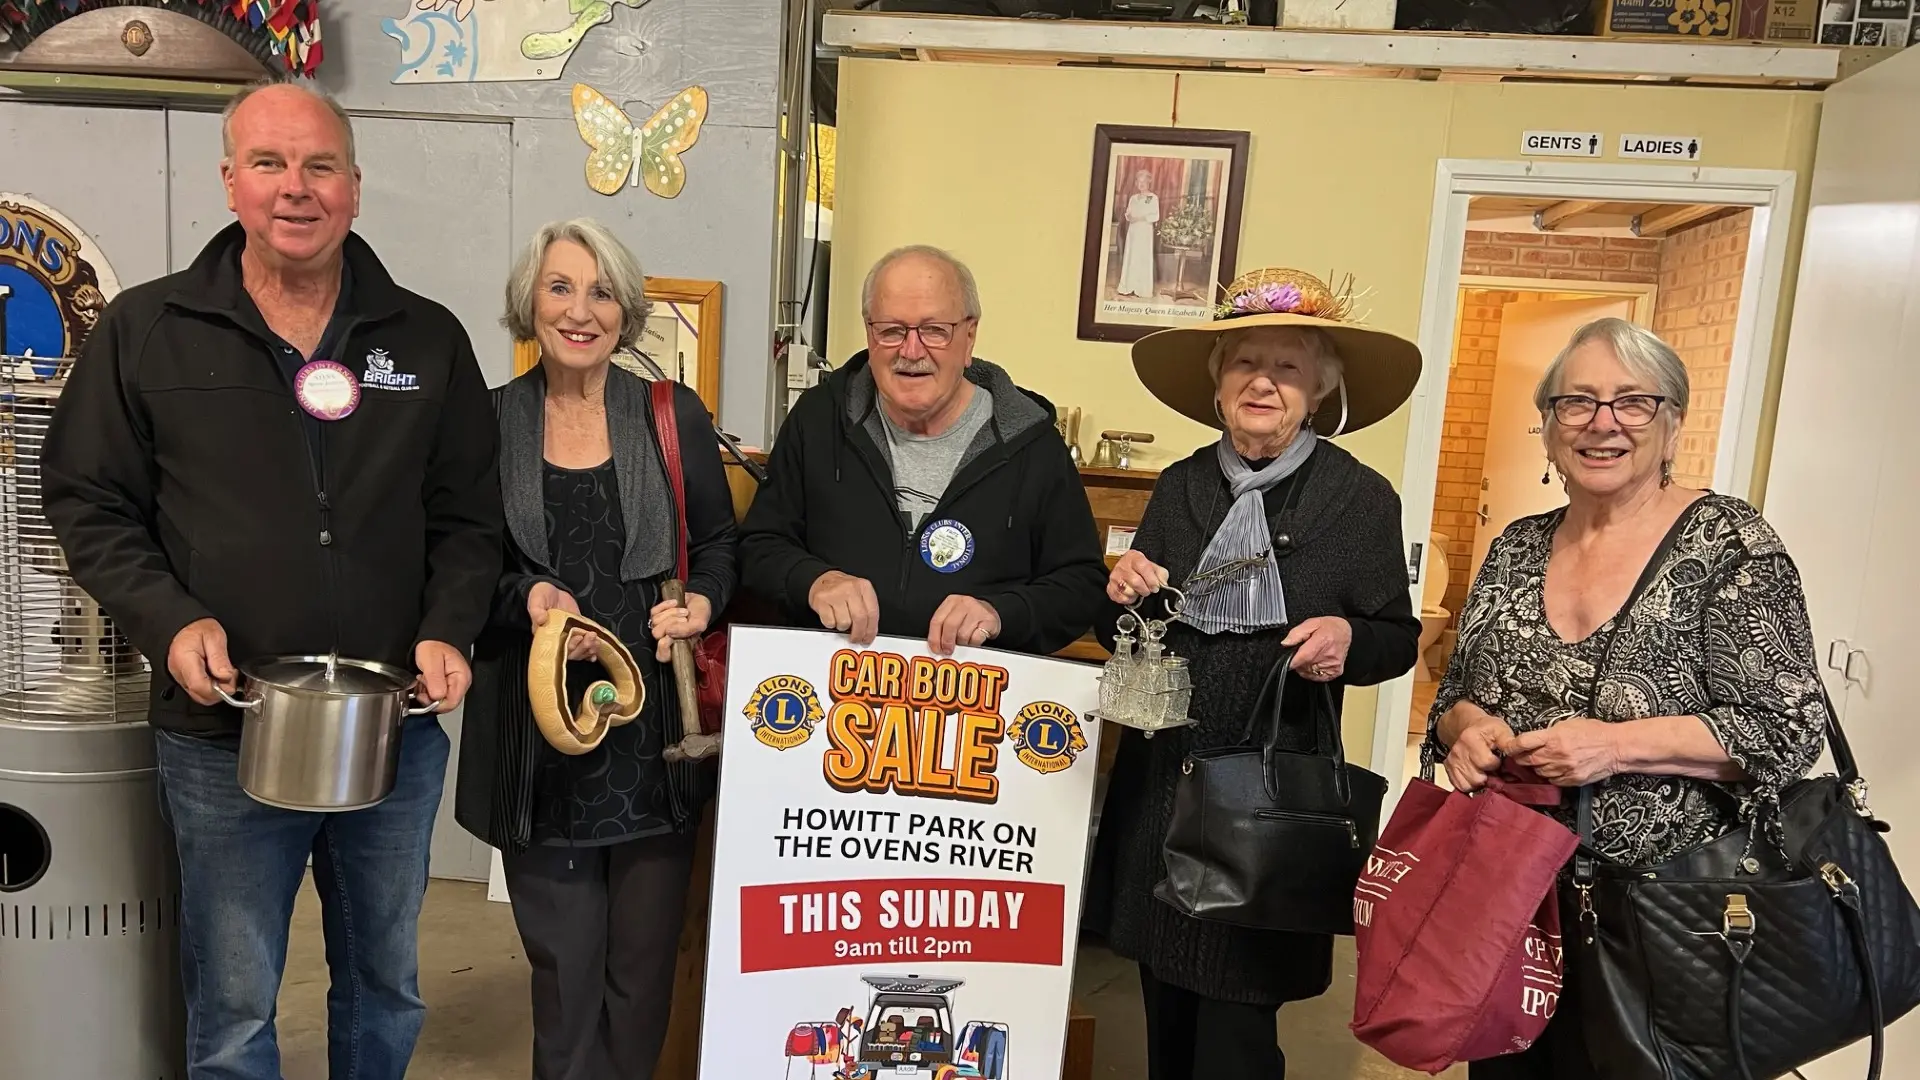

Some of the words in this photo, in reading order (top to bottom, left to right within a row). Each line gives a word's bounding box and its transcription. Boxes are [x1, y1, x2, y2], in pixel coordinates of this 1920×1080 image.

[1773, 6, 1796, 17] X12
[1527, 135, 1582, 150] GENTS
[1624, 139, 1683, 154] LADIES
[1118, 305, 1142, 314] Majesty
[1145, 307, 1166, 315] Queen
[1168, 308, 1198, 316] Elizabeth
[1199, 310, 1206, 318] II
[296, 366, 316, 388] CLUBS
[315, 362, 358, 410] INTERNATIONAL
[363, 369, 417, 386] BRIGHT
[920, 531, 931, 553] LIONS
[930, 519, 953, 531] CLUBS
[951, 521, 974, 569] INTERNATIONAL
[763, 678, 810, 695] LIONS
[831, 652, 905, 700] CAR
[909, 659, 1005, 710] BOOT
[775, 698, 796, 724] L
[1026, 704, 1073, 723] LIONS
[759, 729, 806, 745] INTERNATIONAL
[826, 700, 1001, 794] SALE
[1037, 723, 1058, 750] L
[1022, 751, 1067, 769] INTERNATIONAL
[783, 807, 900, 833] HOWITT
[908, 813, 985, 842] PARK
[993, 823, 1037, 848] ON
[774, 836, 832, 858] THE
[840, 837, 940, 863] OVENS
[949, 844, 1034, 874] RIVER
[779, 891, 862, 935] THIS
[879, 889, 1025, 930] SUNDAY
[834, 939, 882, 958] 9am
[888, 936, 919, 955] till
[924, 936, 972, 958] 2pm
